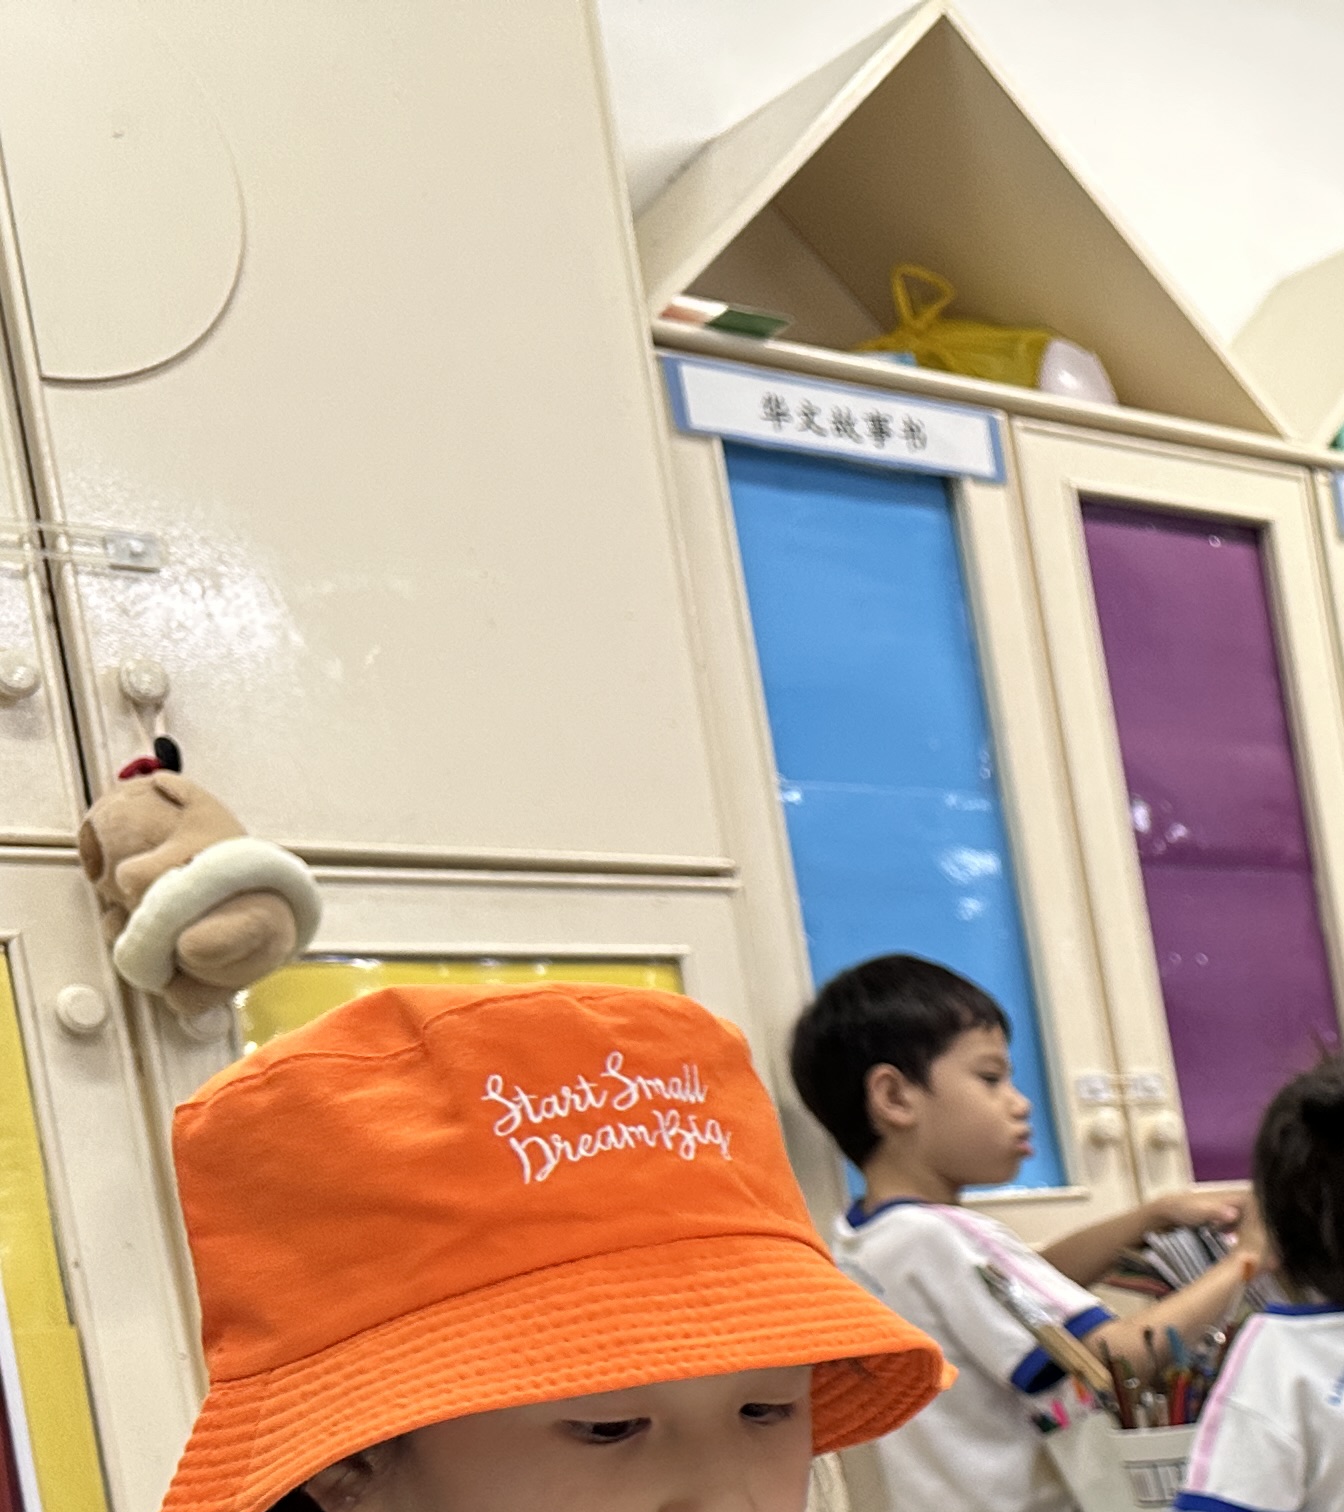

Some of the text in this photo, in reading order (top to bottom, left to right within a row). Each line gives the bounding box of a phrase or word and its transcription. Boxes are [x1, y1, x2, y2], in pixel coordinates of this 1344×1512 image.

[760, 391, 928, 452] 华文故事书
[481, 1051, 708, 1137] Start Small
[509, 1109, 733, 1185] Dream Big
